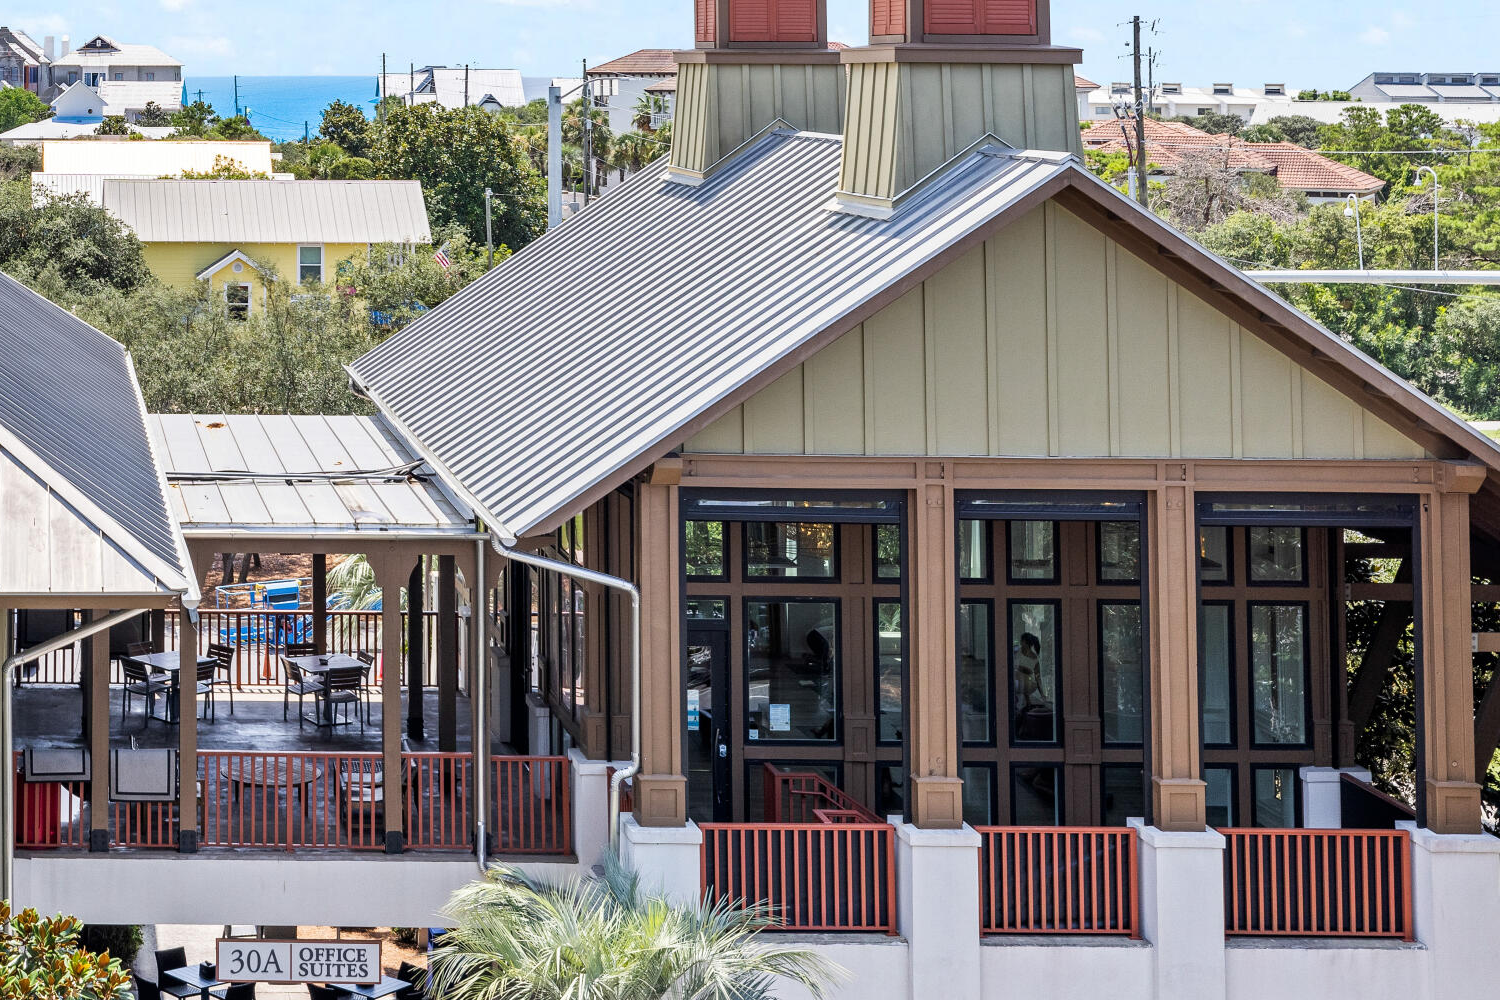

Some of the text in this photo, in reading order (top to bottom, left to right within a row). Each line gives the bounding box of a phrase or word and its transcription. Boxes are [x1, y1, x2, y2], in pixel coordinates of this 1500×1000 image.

[230, 949, 283, 974] 30A
[299, 948, 368, 962] OFFICE
[299, 963, 369, 978] SUITES
